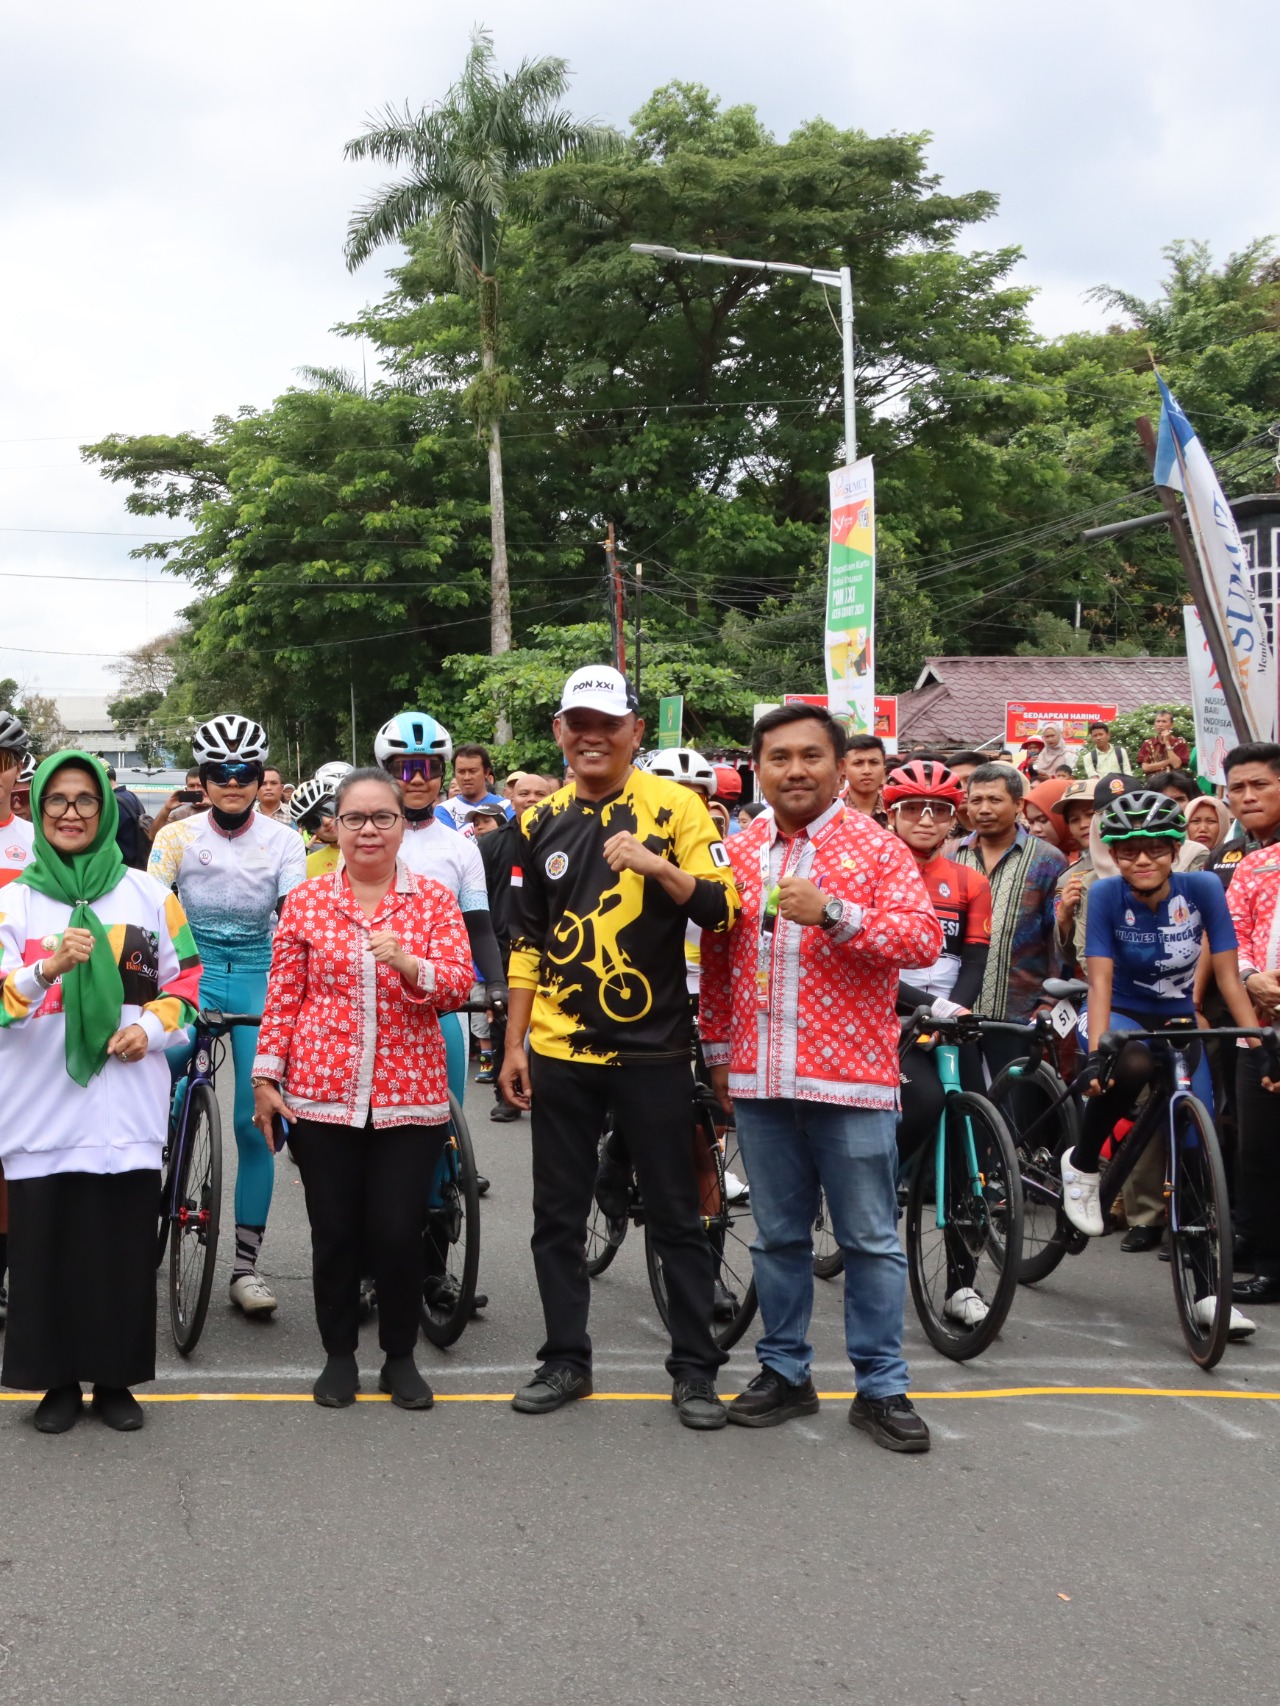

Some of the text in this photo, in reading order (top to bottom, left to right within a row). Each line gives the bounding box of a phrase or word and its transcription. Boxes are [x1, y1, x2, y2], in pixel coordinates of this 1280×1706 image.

[572, 680, 594, 693] PON
[596, 680, 614, 691] XXI
[1023, 711, 1100, 720] SEDAAPKAN HARIMU
[1058, 1009, 1071, 1027] 51
